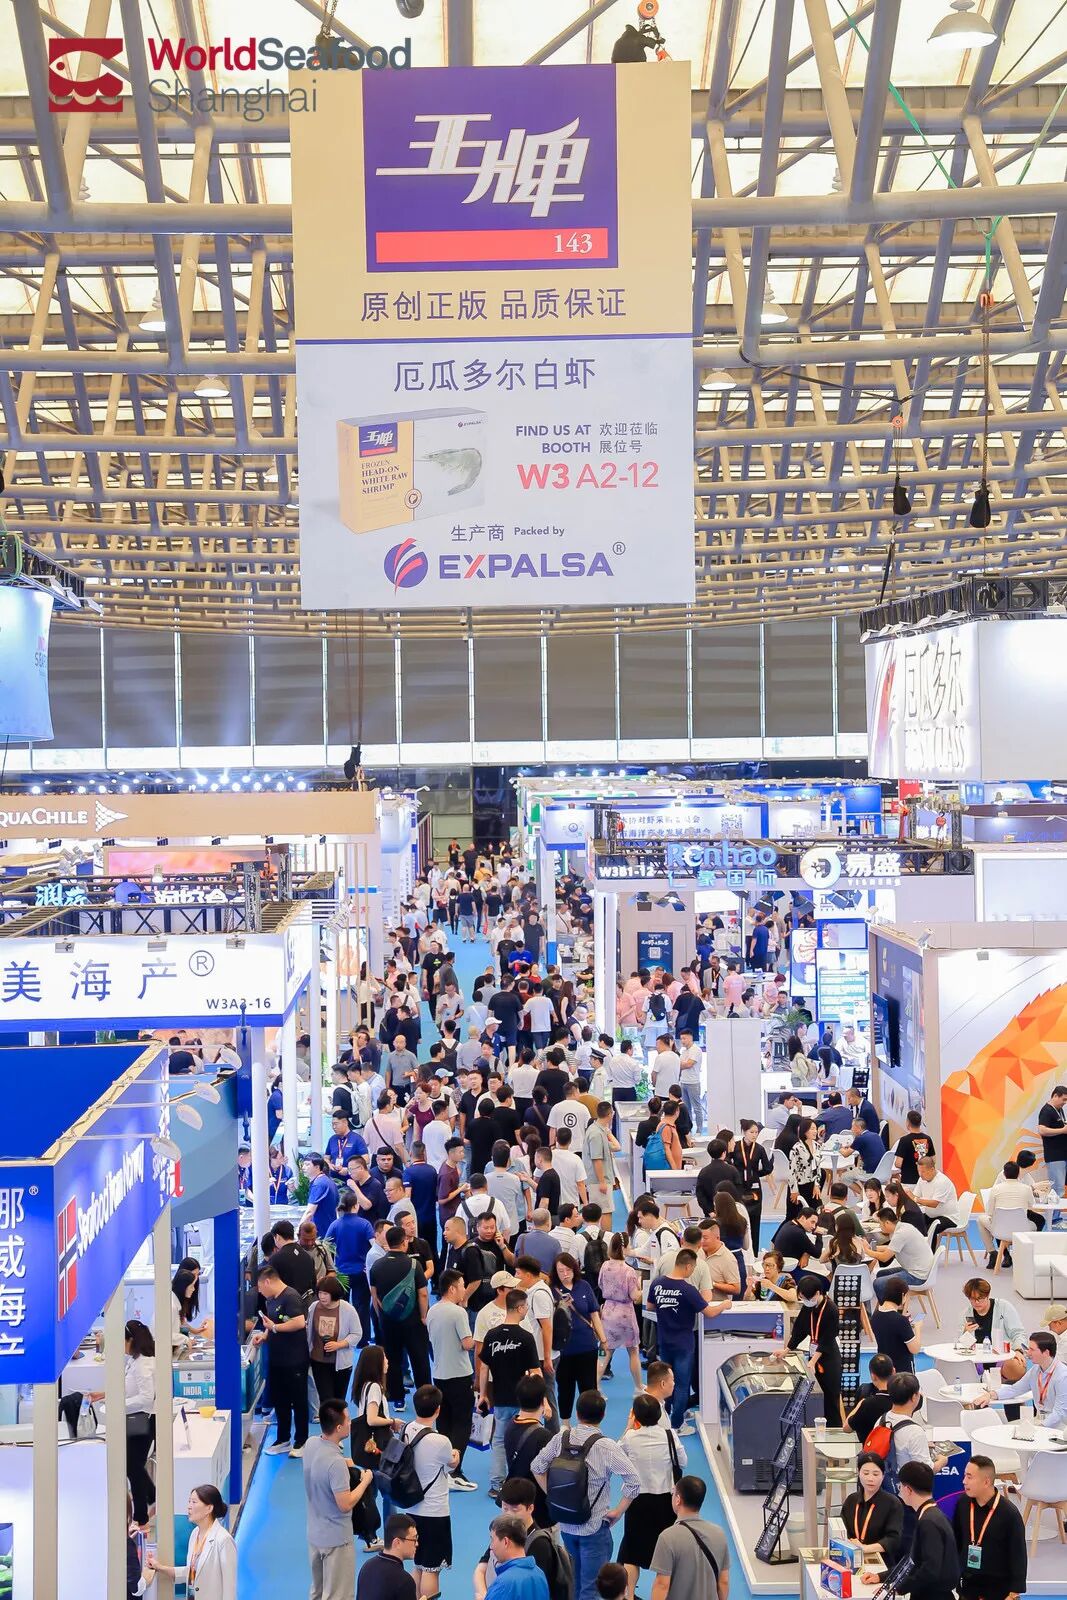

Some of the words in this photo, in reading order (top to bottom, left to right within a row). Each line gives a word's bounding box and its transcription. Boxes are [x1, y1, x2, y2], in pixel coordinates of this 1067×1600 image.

[376, 113, 590, 217] 王牌
[554, 233, 592, 254] 143
[361, 289, 488, 322] 原创正版
[500, 287, 627, 320] 品质保证
[394, 357, 596, 392] 厄瓜多尔白虾
[515, 425, 549, 436] FIND
[553, 425, 571, 436] US
[574, 424, 592, 435] AT
[599, 422, 659, 436] 欢迎莅临
[541, 442, 591, 453] BOOTH
[599, 440, 643, 454] 展位号
[361, 459, 390, 469] FROZEN
[361, 465, 400, 477] HEAD-ON
[361, 474, 390, 486] WHITE
[391, 472, 409, 482] RAW
[517, 463, 570, 490] W3
[576, 461, 660, 488] A2-12
[361, 483, 395, 494] SHRIMP
[451, 524, 505, 542] 生产商
[514, 526, 550, 536] Packed
[552, 526, 565, 537] by
[439, 552, 614, 579] EXPALSA
[599, 864, 655, 878] W3B1-12
[846, 852, 902, 877] 易盛
[654, 1284, 682, 1296] Puma
[656, 1296, 679, 1306] Team
